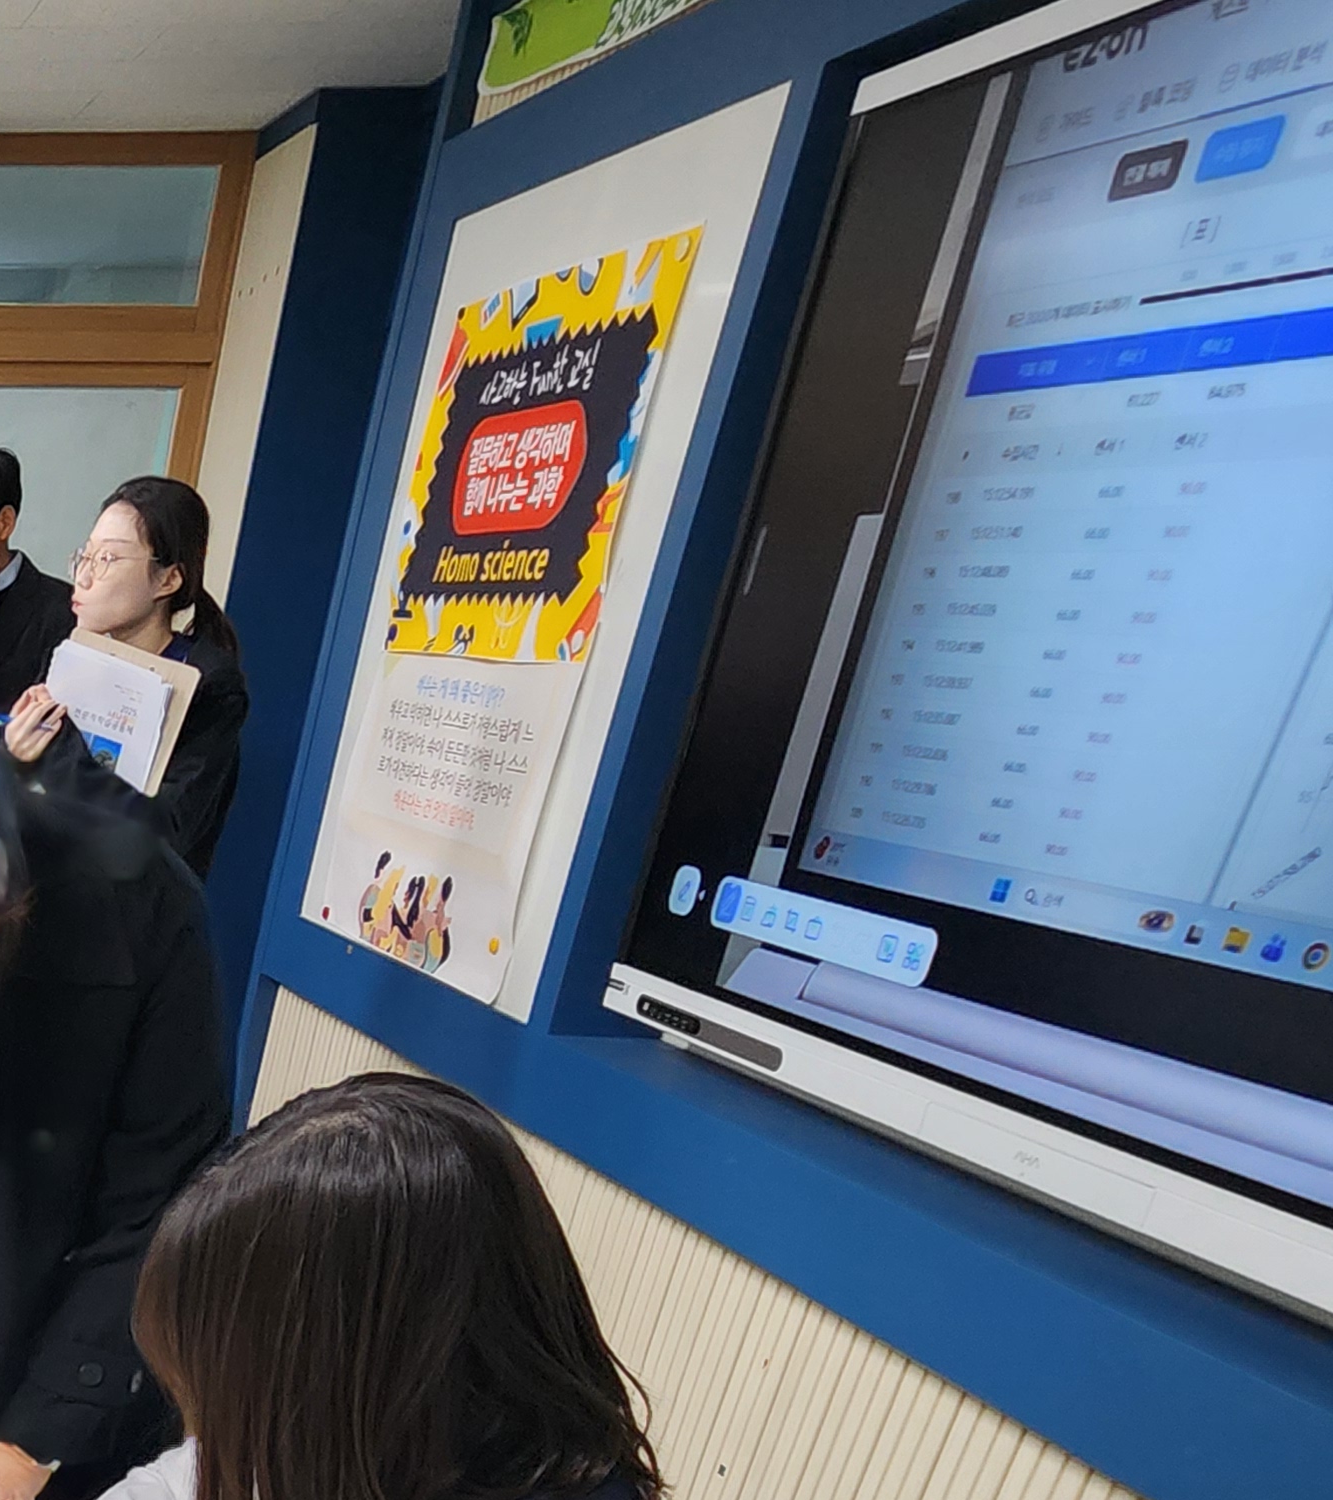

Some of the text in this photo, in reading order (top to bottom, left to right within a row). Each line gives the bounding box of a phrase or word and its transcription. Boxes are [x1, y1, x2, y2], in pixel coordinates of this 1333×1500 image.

[1245, 51, 1290, 82] 데이터
[1291, 40, 1328, 72] 분석
[479, 338, 602, 405] 사고하는 Fun한 교실
[466, 419, 577, 476] 질문하고 생각하며
[463, 466, 565, 517] 함께 나누는 과학
[432, 539, 550, 584] Homo science
[506, 754, 528, 773] 스스
